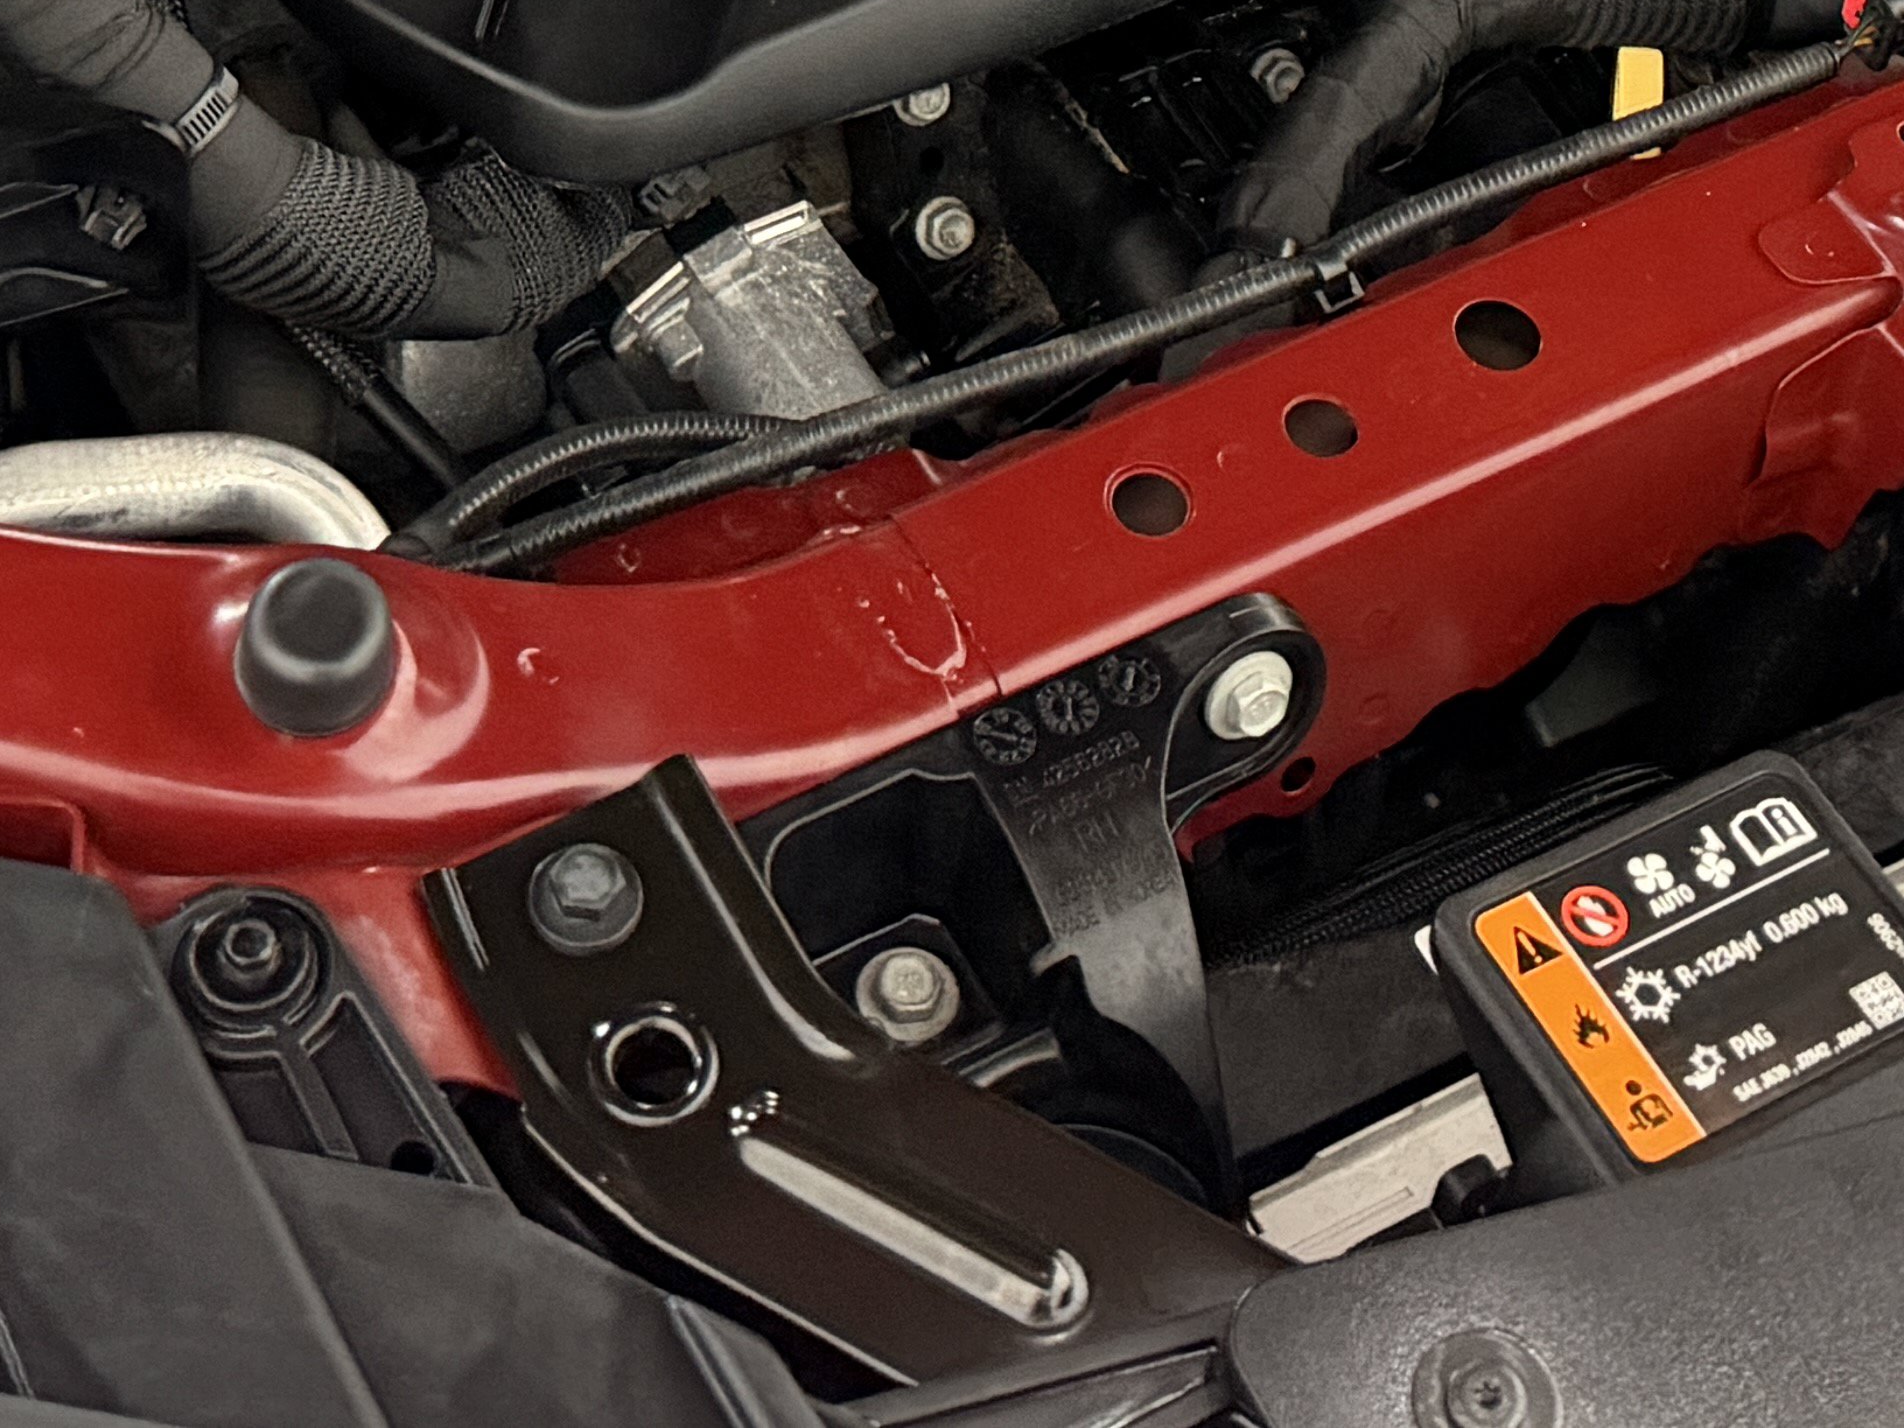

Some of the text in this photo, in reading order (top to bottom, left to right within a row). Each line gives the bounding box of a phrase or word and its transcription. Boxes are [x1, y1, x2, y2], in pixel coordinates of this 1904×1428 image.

[1648, 884, 1696, 918] AUTO
[1674, 892, 1849, 989] R-1234yf 0.600 kg
[1728, 1022, 1777, 1061] PAG
[1732, 1077, 1763, 1102] SAE
